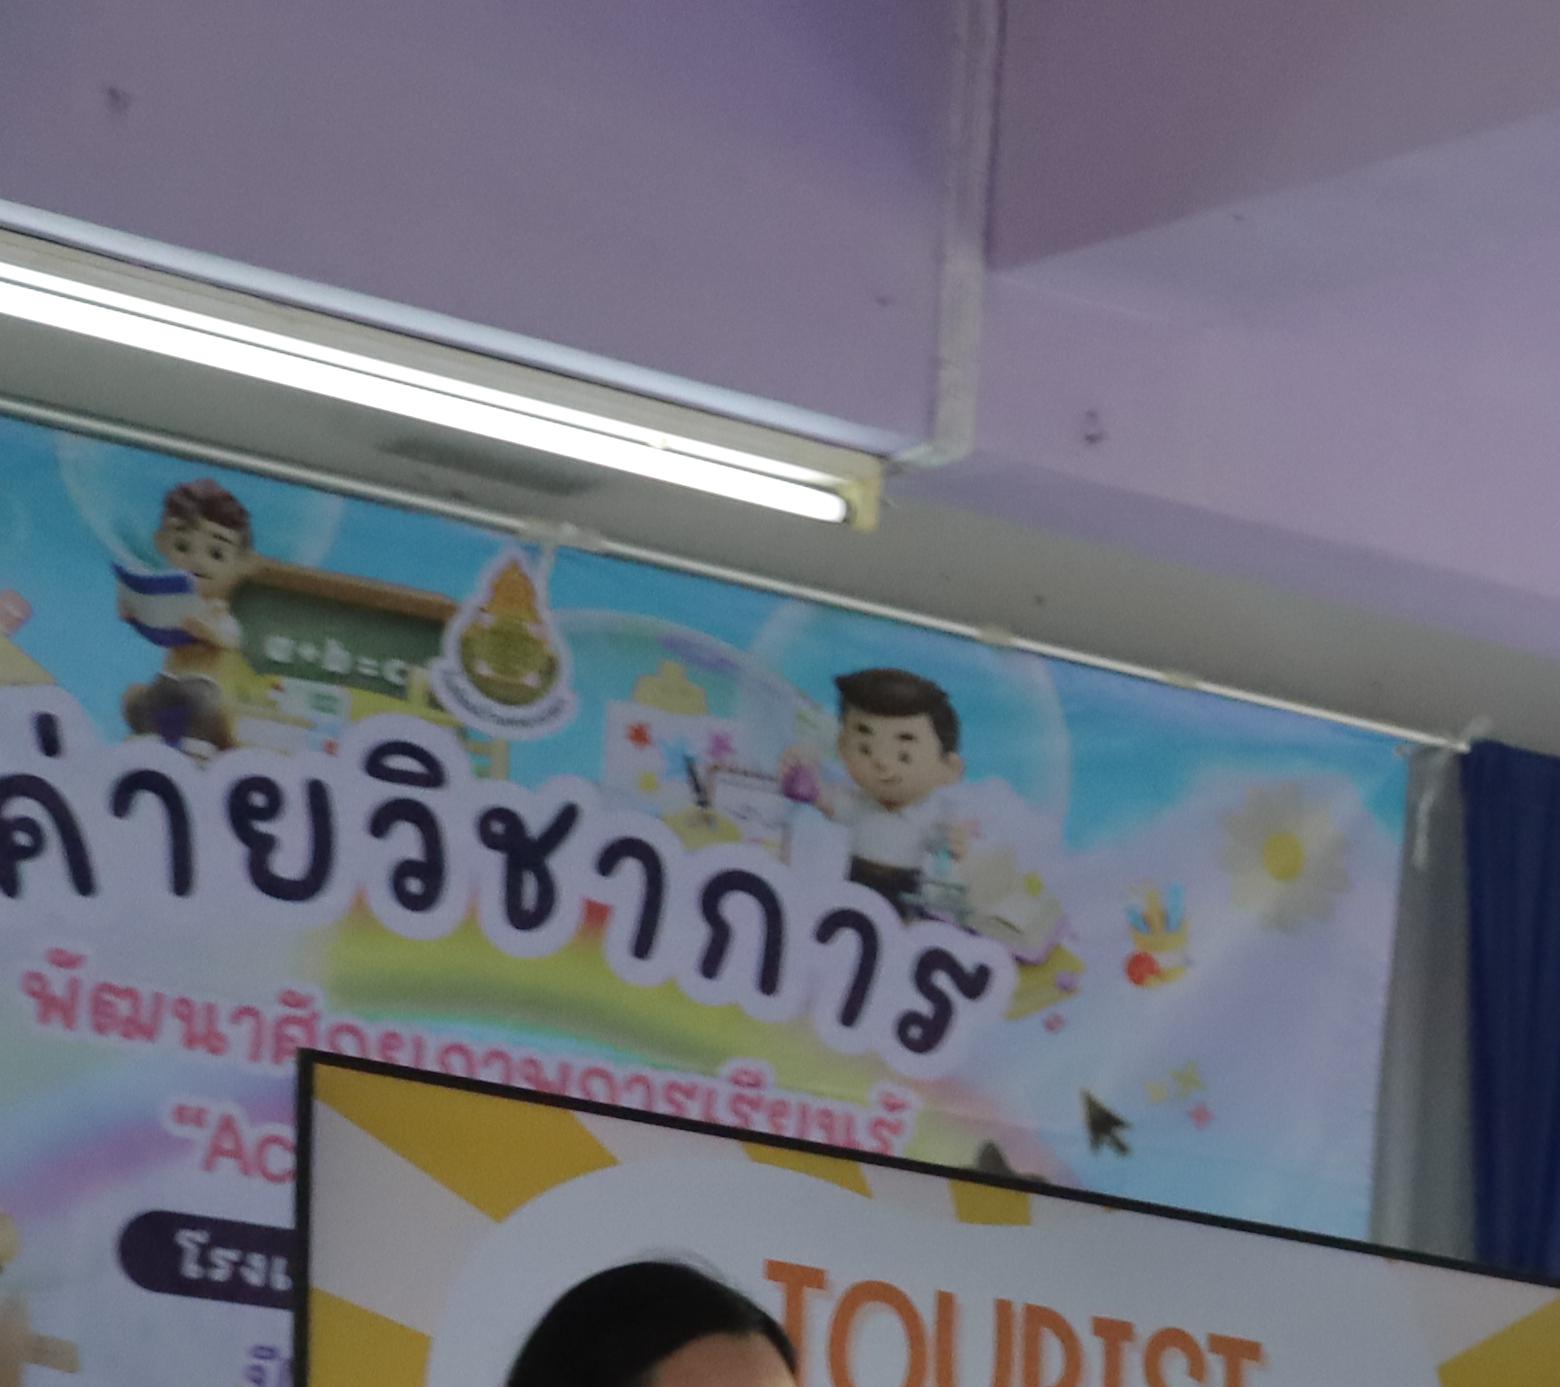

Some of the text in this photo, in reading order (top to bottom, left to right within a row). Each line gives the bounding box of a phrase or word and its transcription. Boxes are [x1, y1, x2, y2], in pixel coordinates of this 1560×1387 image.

[0, 711, 991, 1054] ค่ายวิชาการ
